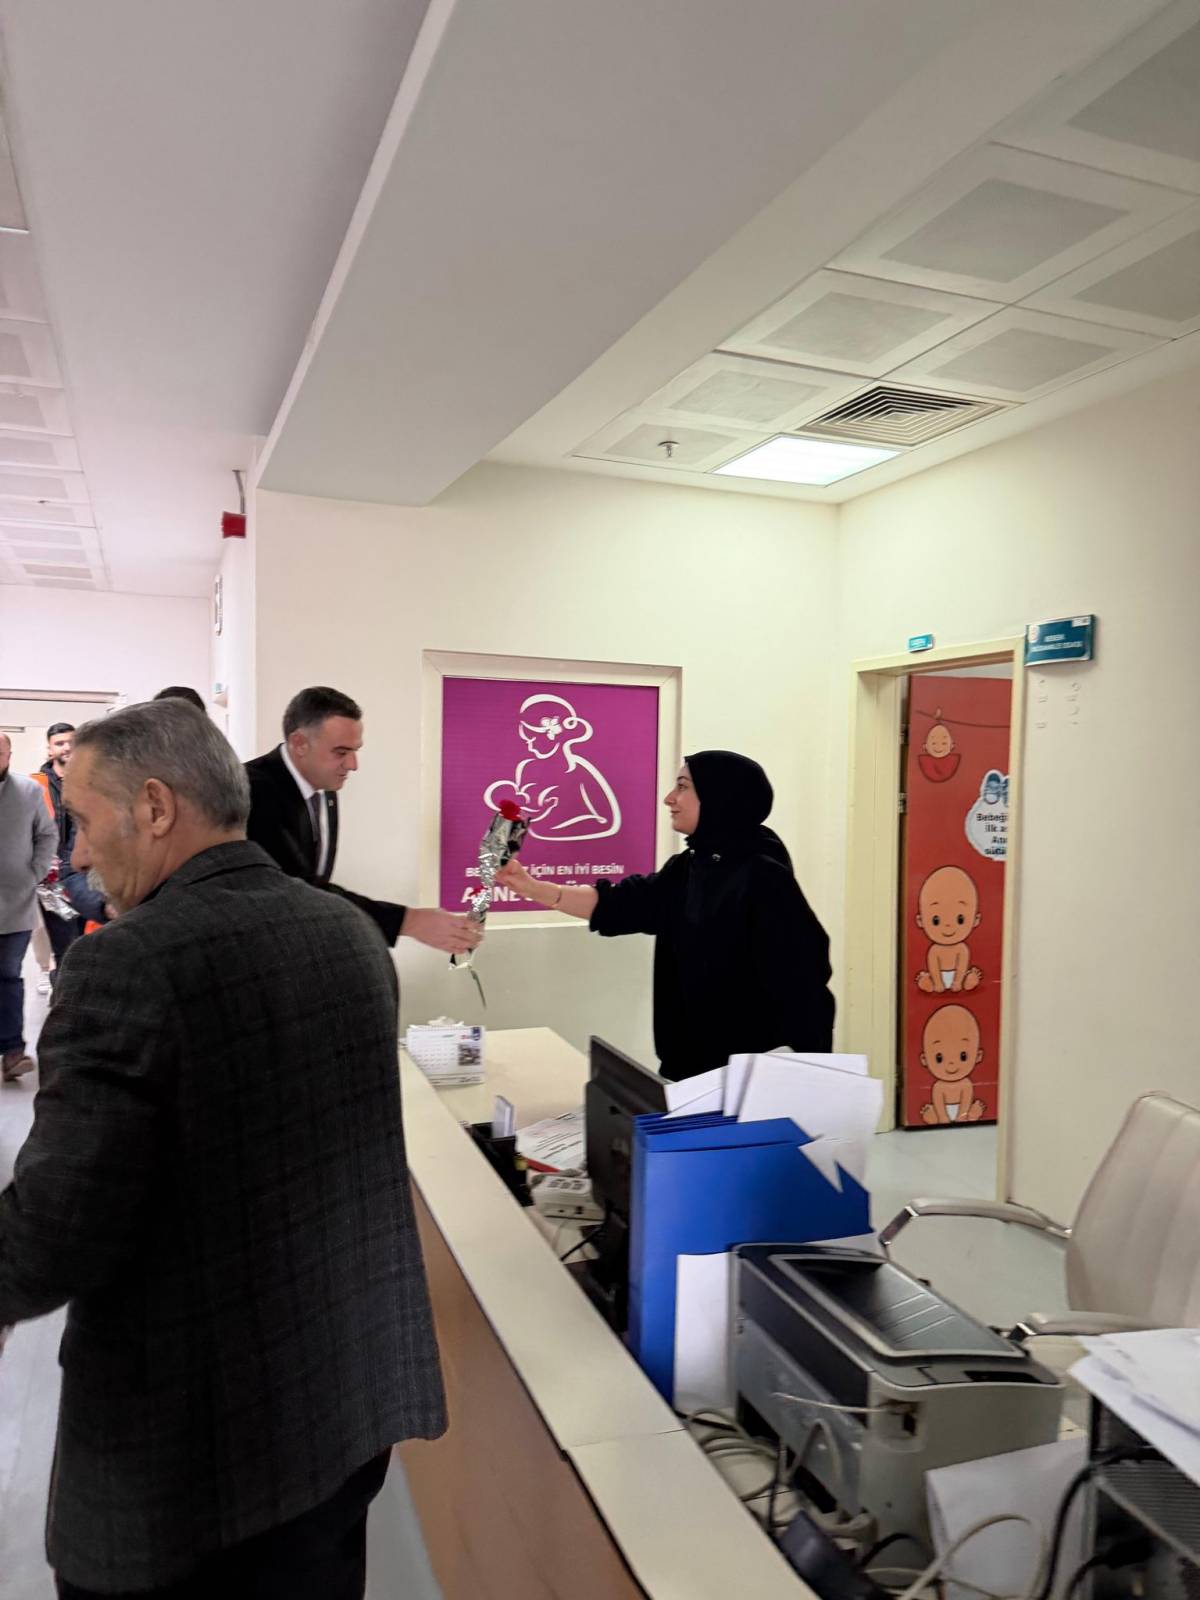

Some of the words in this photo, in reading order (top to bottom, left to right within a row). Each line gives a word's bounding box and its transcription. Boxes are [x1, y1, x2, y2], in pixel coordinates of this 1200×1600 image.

[531, 863, 555, 877] İÇİN
[557, 864, 572, 875] EN
[574, 863, 590, 874] İYİ
[591, 862, 625, 875] BESİN
